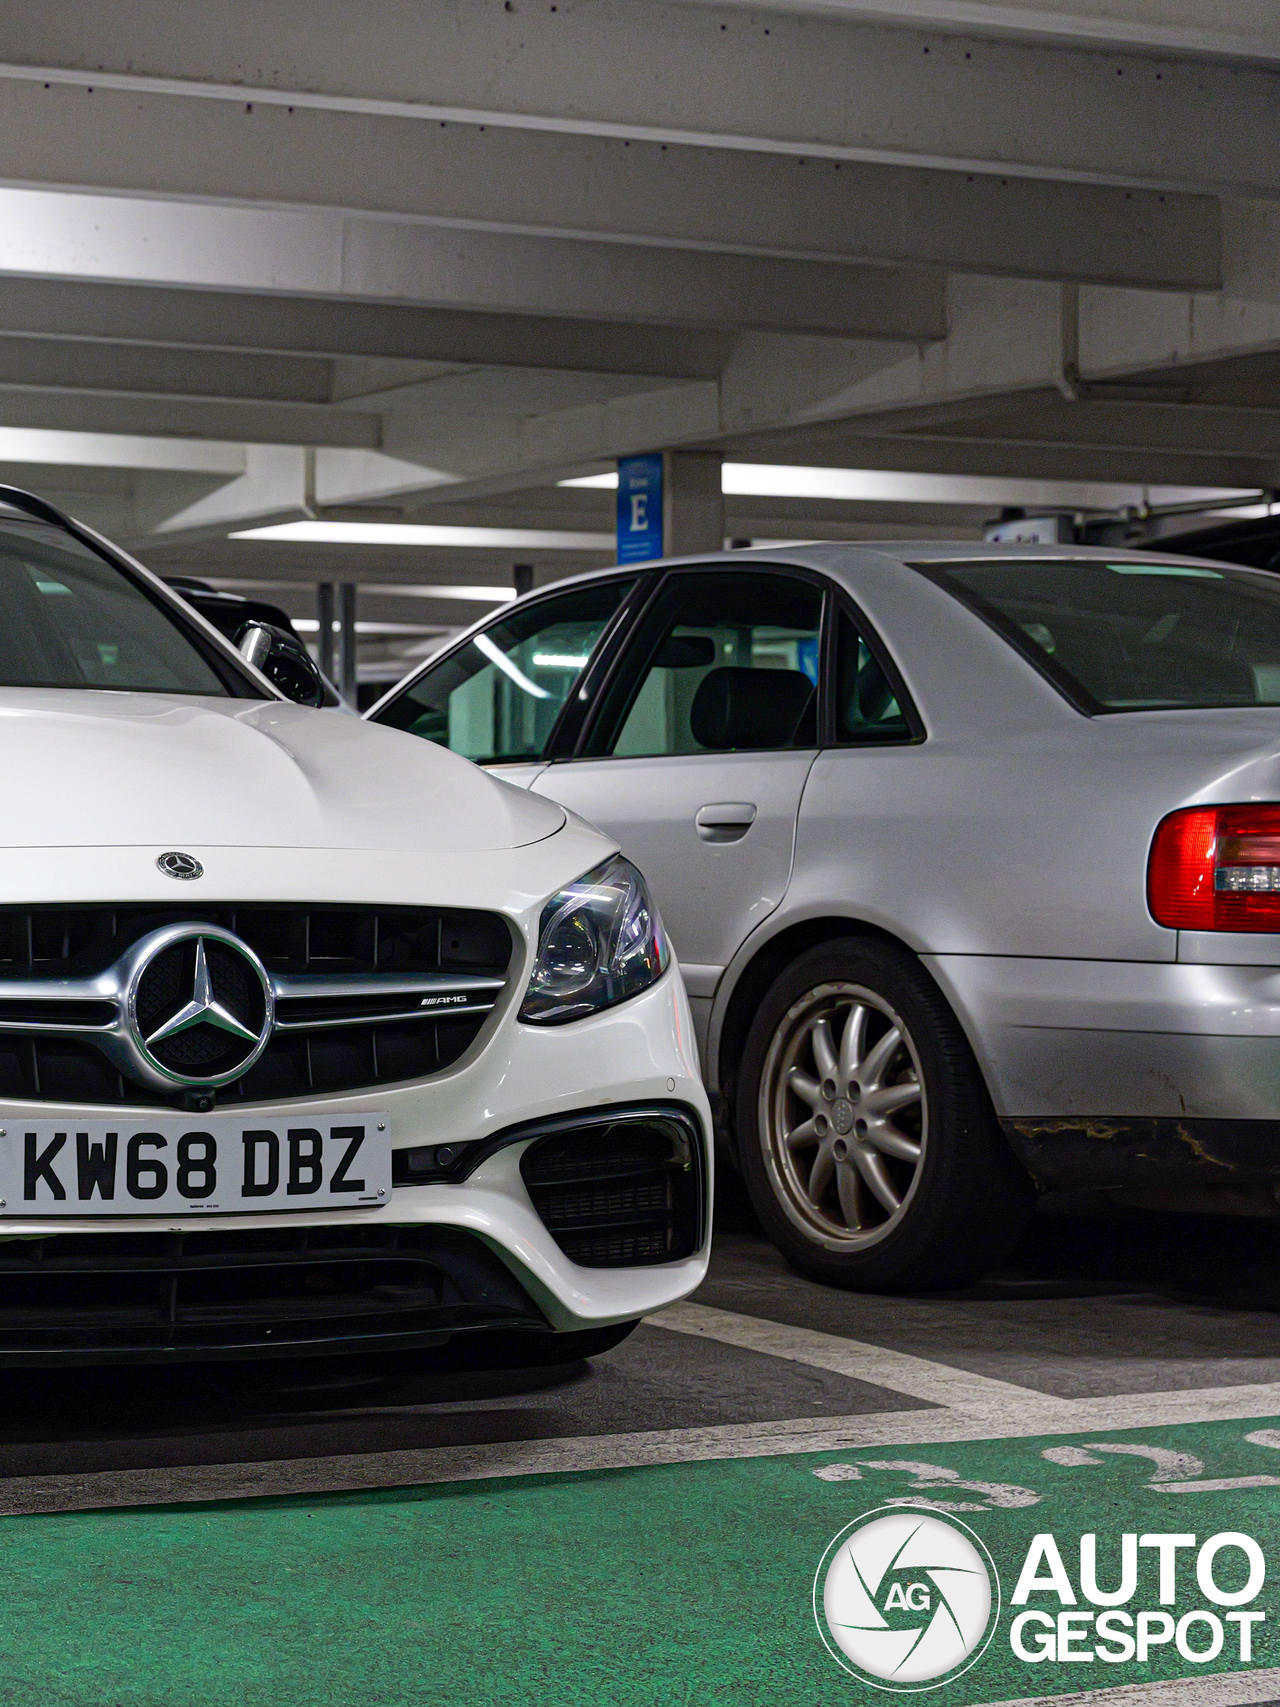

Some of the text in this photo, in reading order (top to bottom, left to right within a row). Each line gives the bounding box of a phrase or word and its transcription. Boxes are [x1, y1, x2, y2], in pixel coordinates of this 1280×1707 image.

[629, 493, 649, 532] E
[23, 1125, 366, 1201] KW68 DBZ
